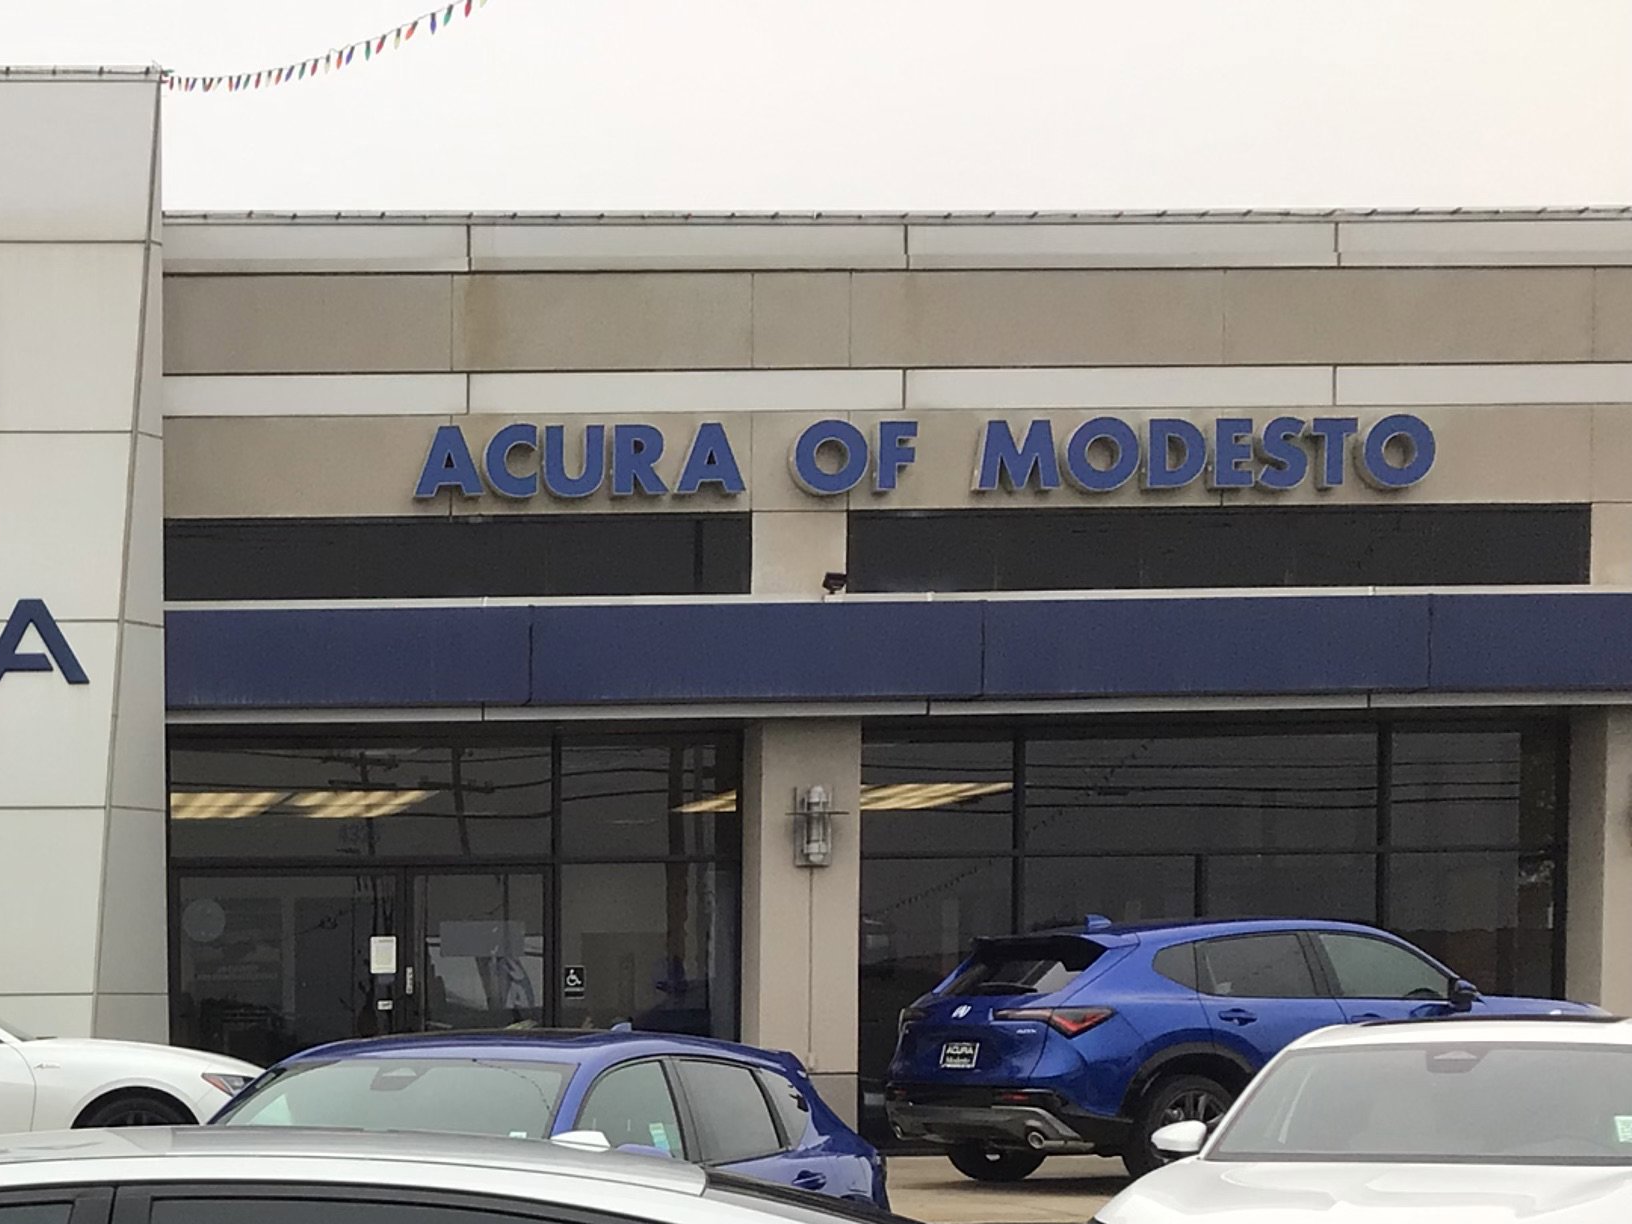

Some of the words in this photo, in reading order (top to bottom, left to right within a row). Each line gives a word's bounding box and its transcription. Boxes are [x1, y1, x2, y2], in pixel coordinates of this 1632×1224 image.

[414, 422, 747, 499] ACURA
[788, 418, 918, 496] OF
[971, 413, 1437, 491] MODESTO
[946, 1045, 974, 1055] ACURA
